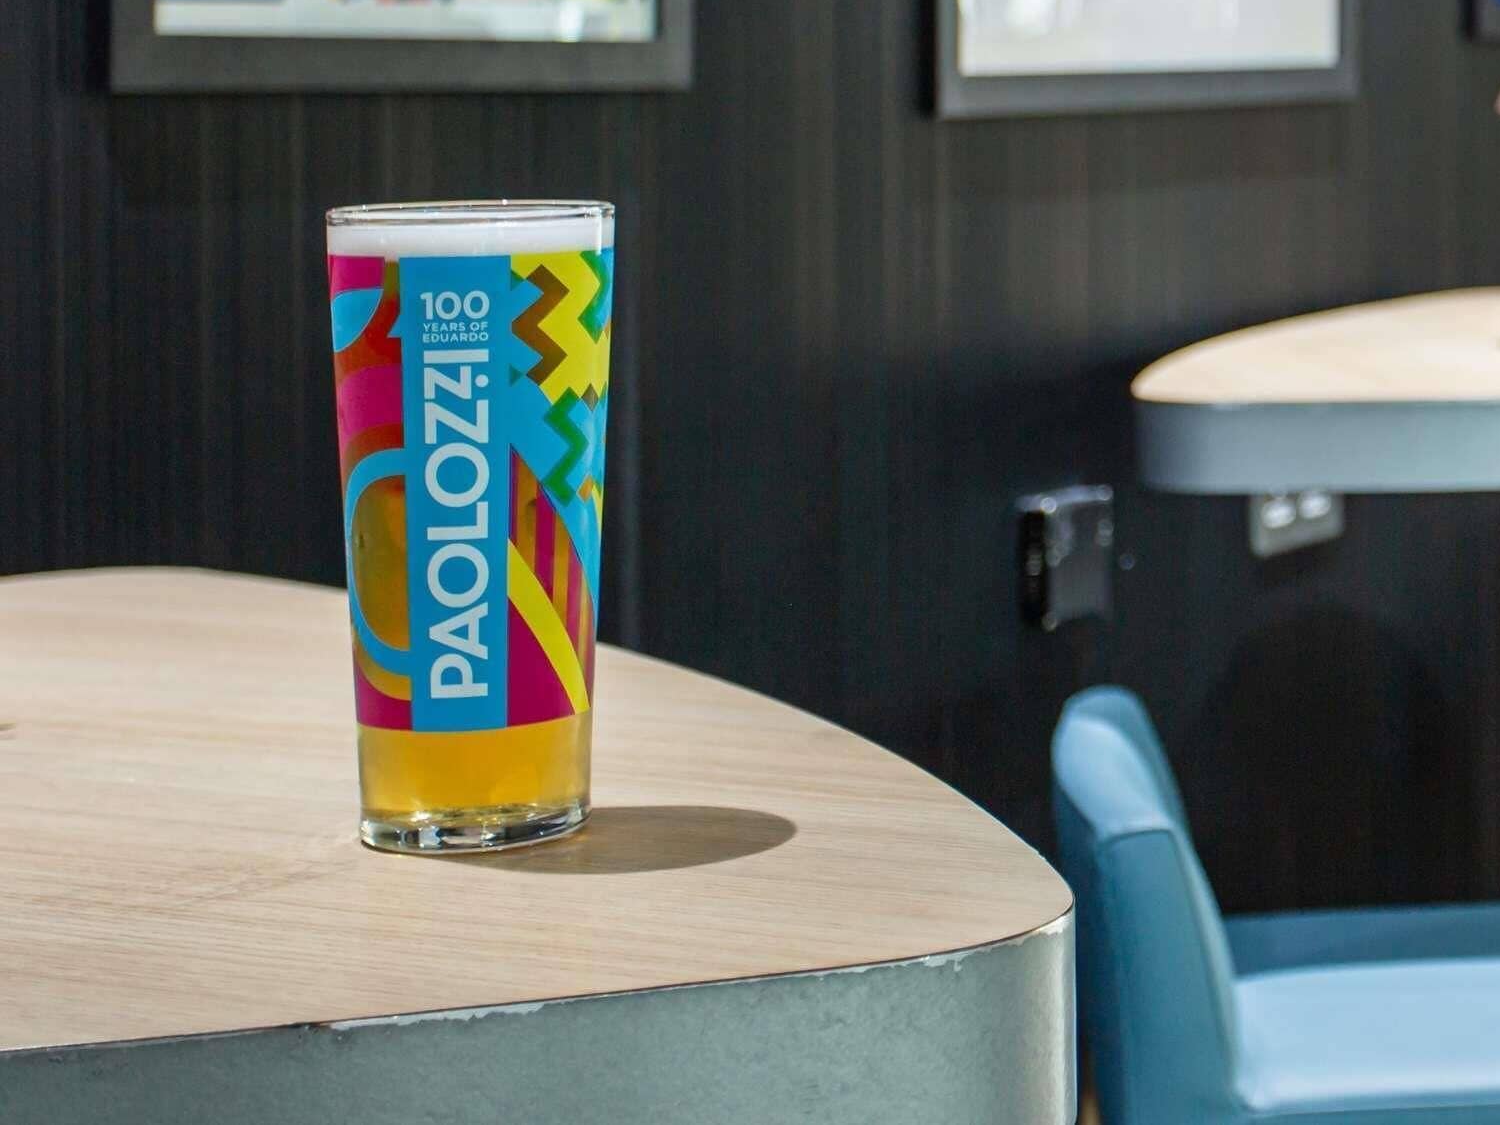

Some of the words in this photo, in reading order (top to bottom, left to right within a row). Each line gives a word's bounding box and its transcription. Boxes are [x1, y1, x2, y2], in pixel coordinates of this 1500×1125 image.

[420, 290, 490, 320] 100
[423, 322, 466, 332] YEARS
[469, 321, 489, 332] OF
[422, 332, 489, 343] EDUARDO
[423, 349, 490, 700] PAOLOZZI
